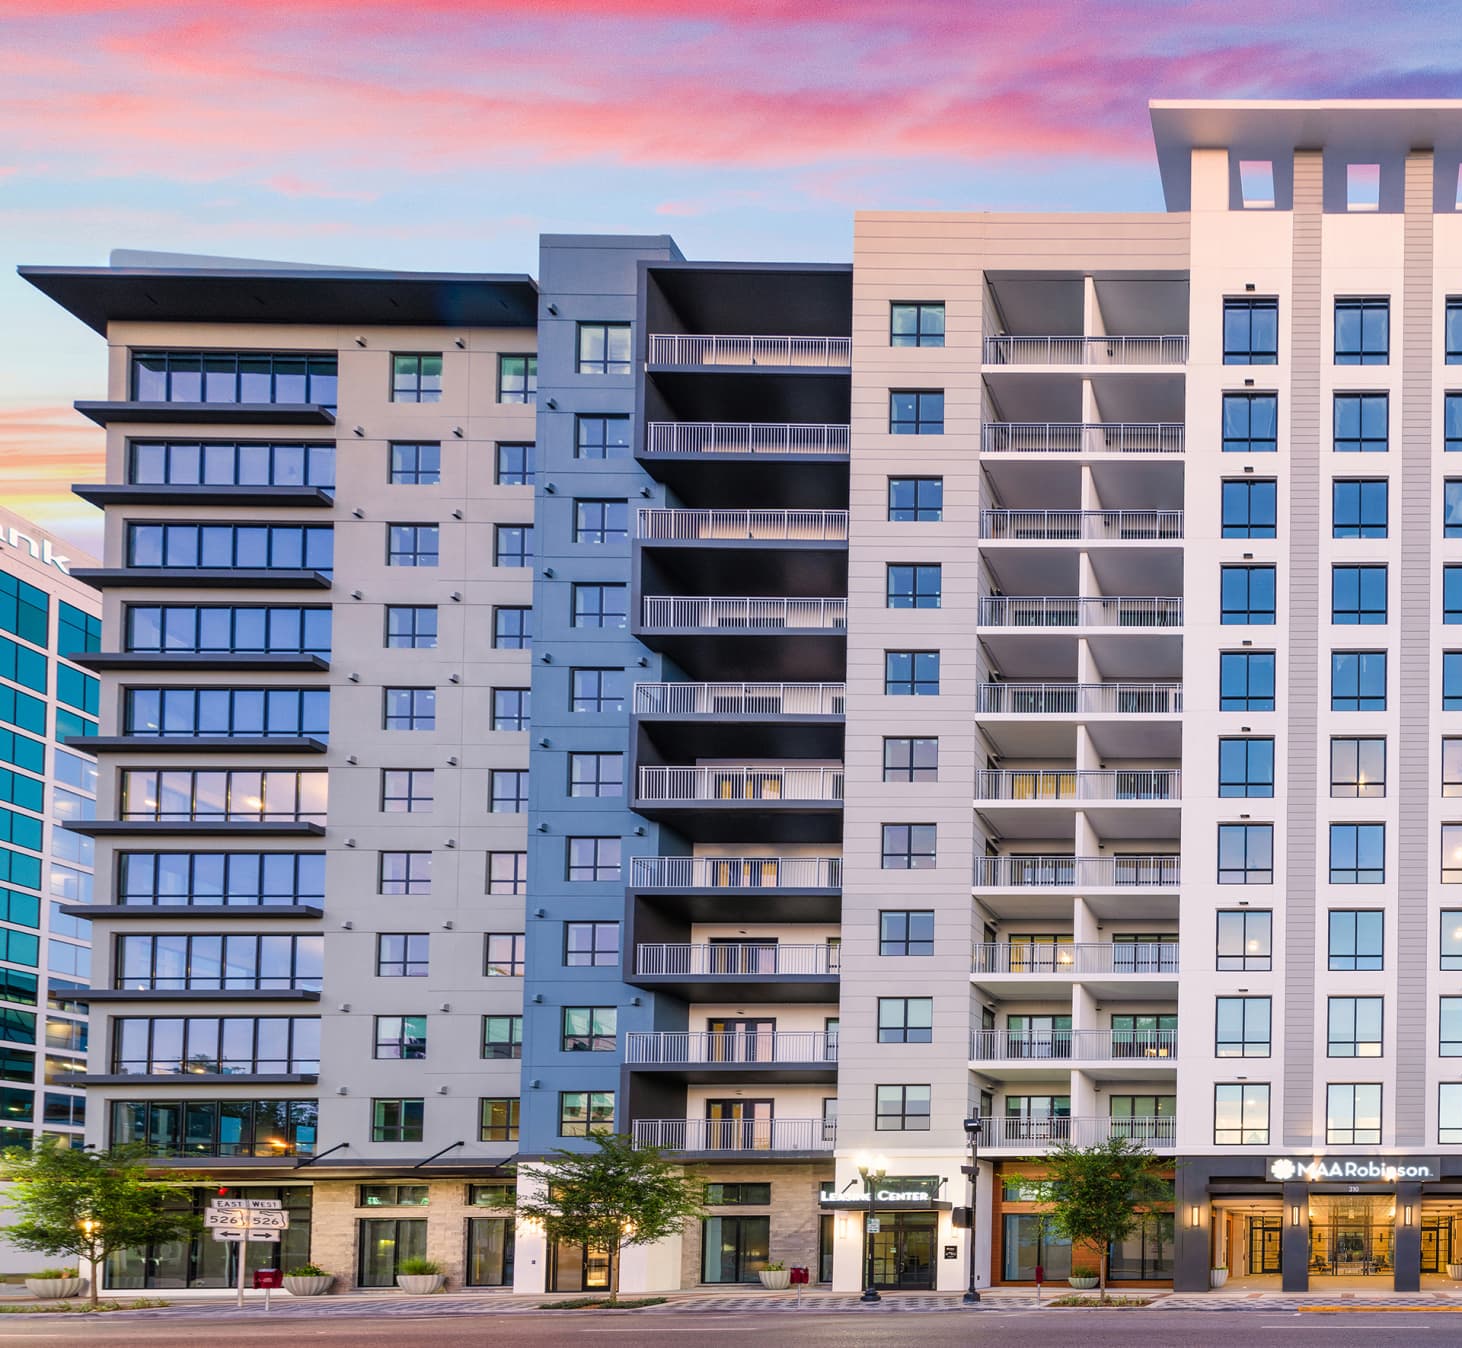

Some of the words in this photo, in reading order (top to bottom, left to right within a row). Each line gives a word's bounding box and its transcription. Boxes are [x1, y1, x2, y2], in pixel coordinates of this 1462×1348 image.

[877, 1190, 929, 1200] CENTER
[217, 1200, 242, 1208] EAST
[251, 1200, 277, 1208] WEST
[210, 1215, 238, 1224] 526
[253, 1217, 279, 1225] 526
